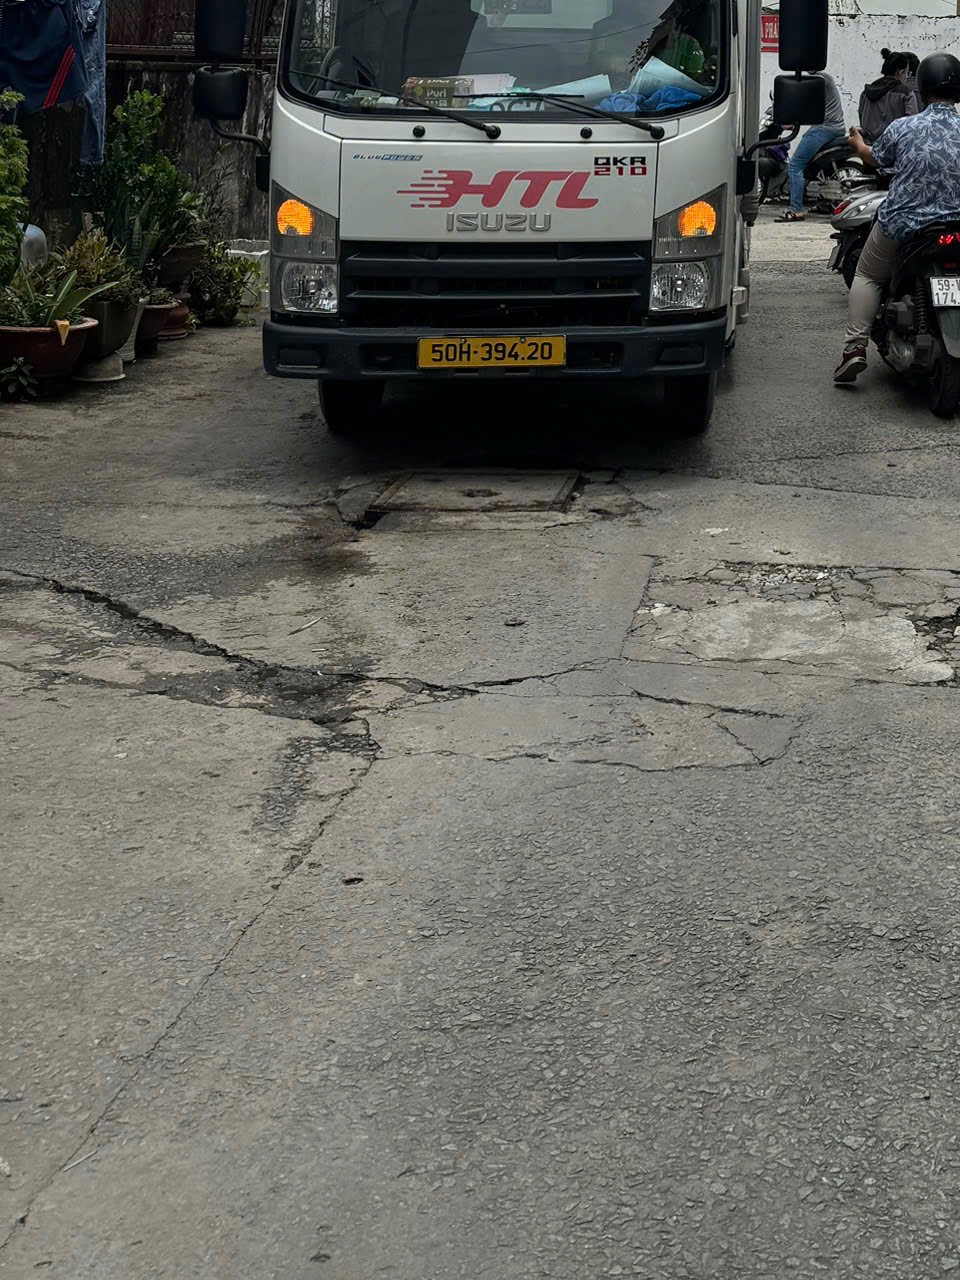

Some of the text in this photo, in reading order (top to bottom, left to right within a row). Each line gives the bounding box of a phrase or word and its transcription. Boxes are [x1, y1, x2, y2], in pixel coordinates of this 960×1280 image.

[594, 156, 647, 166] QKR
[594, 167, 647, 176] 210
[410, 170, 600, 209] HTL
[446, 212, 552, 232] ISUZU
[431, 341, 553, 363] 50H-394.20
